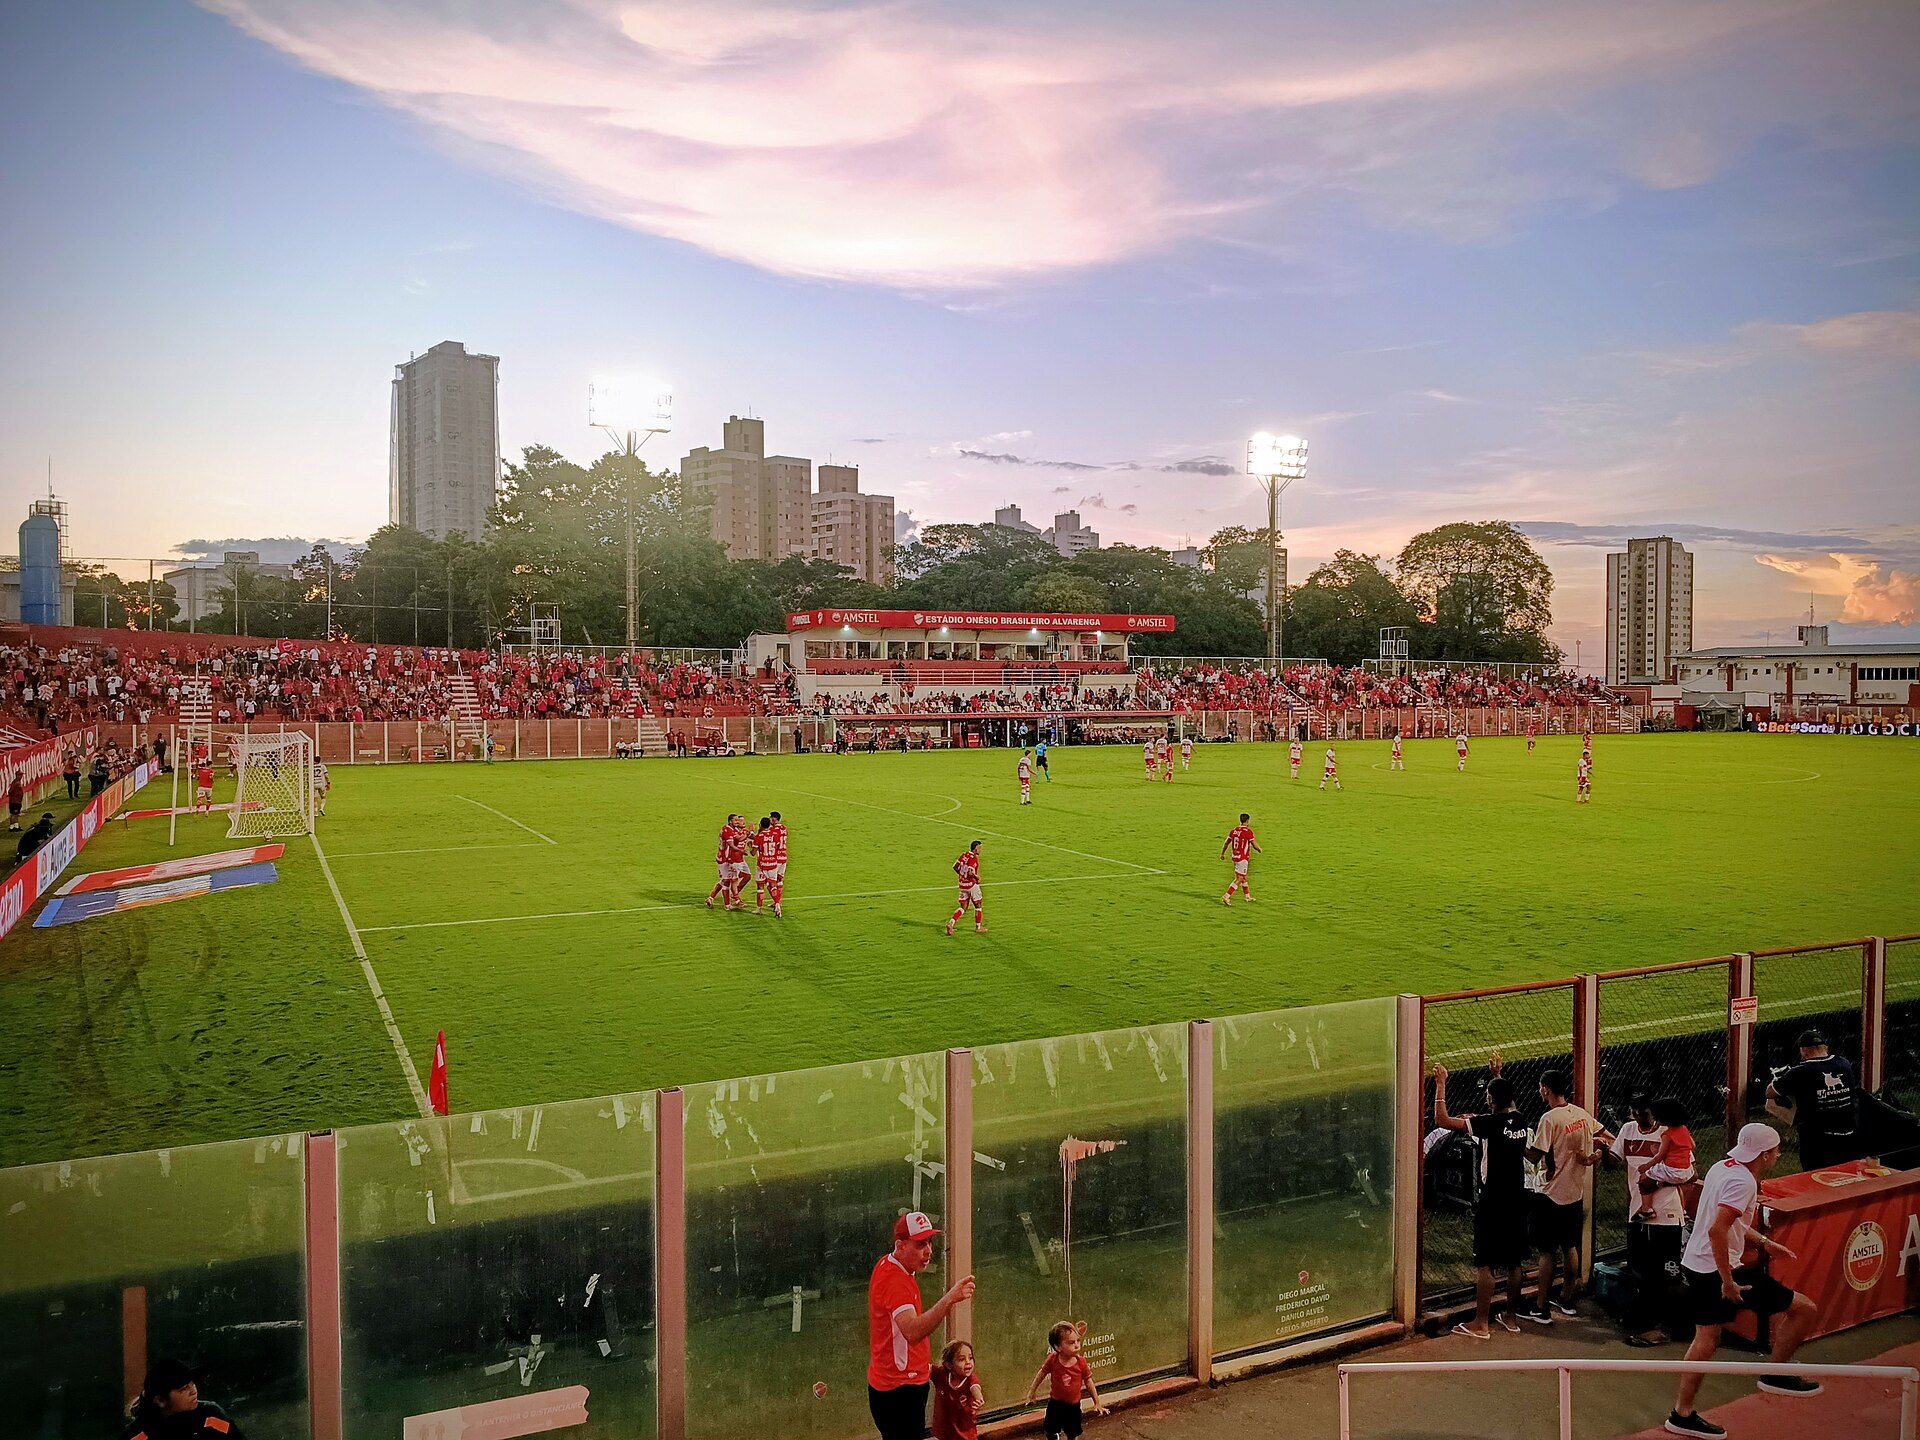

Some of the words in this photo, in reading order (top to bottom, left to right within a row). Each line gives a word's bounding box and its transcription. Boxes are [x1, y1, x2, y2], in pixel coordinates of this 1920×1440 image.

[842, 612, 880, 623] AMSTEL
[925, 614, 964, 624] ESTÁDIO
[965, 615, 999, 625] ONÉSIO
[1000, 616, 1051, 625] BRASILEIRO
[1052, 617, 1101, 627] ALVARENGA
[1136, 617, 1168, 627] AMSTEL
[763, 842, 776, 857] 15
[1852, 1243, 1880, 1260] AMSTEL
[1896, 1214, 1920, 1277] A
[1279, 1290, 1298, 1300] DIEGO
[1300, 1284, 1325, 1294] MARÇAL
[1276, 1299, 1309, 1312] FREDERICO
[1310, 1294, 1329, 1303] DAVID
[1281, 1311, 1304, 1322] DANILO
[1306, 1306, 1324, 1316] ALVES
[1276, 1323, 1299, 1334] CARLOS
[1301, 1316, 1329, 1328] ROBERTO
[1082, 1333, 1114, 1346] ALMEIDA
[1083, 1346, 1115, 1358] ALMEIDA
[480, 1413, 520, 1426] ANTENHA
